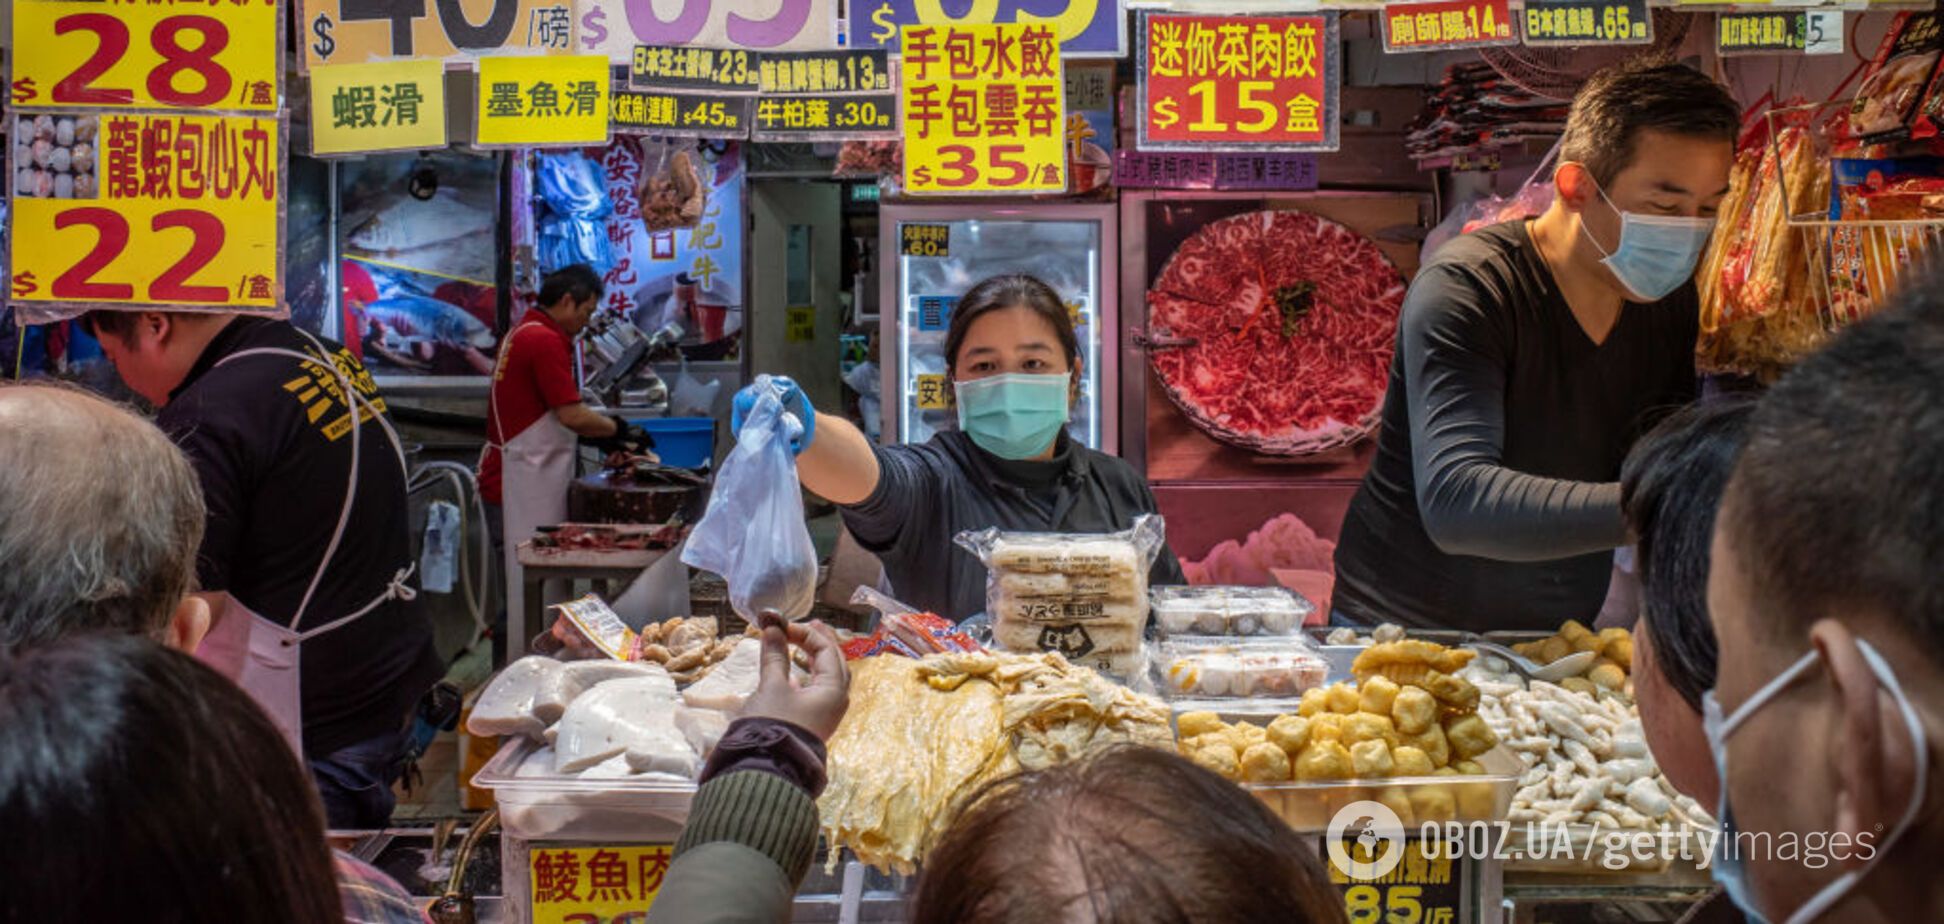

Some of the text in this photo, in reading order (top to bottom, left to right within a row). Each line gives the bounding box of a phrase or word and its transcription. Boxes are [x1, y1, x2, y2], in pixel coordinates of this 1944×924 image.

[906, 25, 1055, 80] 手包水餃
[1151, 21, 1316, 78] 迷你菜肉餃
[332, 82, 423, 128] 蝦滑
[486, 81, 601, 118] 墨魚滑
[758, 99, 829, 128] 牛柏葉
[908, 83, 1057, 138] 手包雲吞
[108, 116, 274, 200] 龍蝦包心丸
[921, 378, 950, 406] 安
